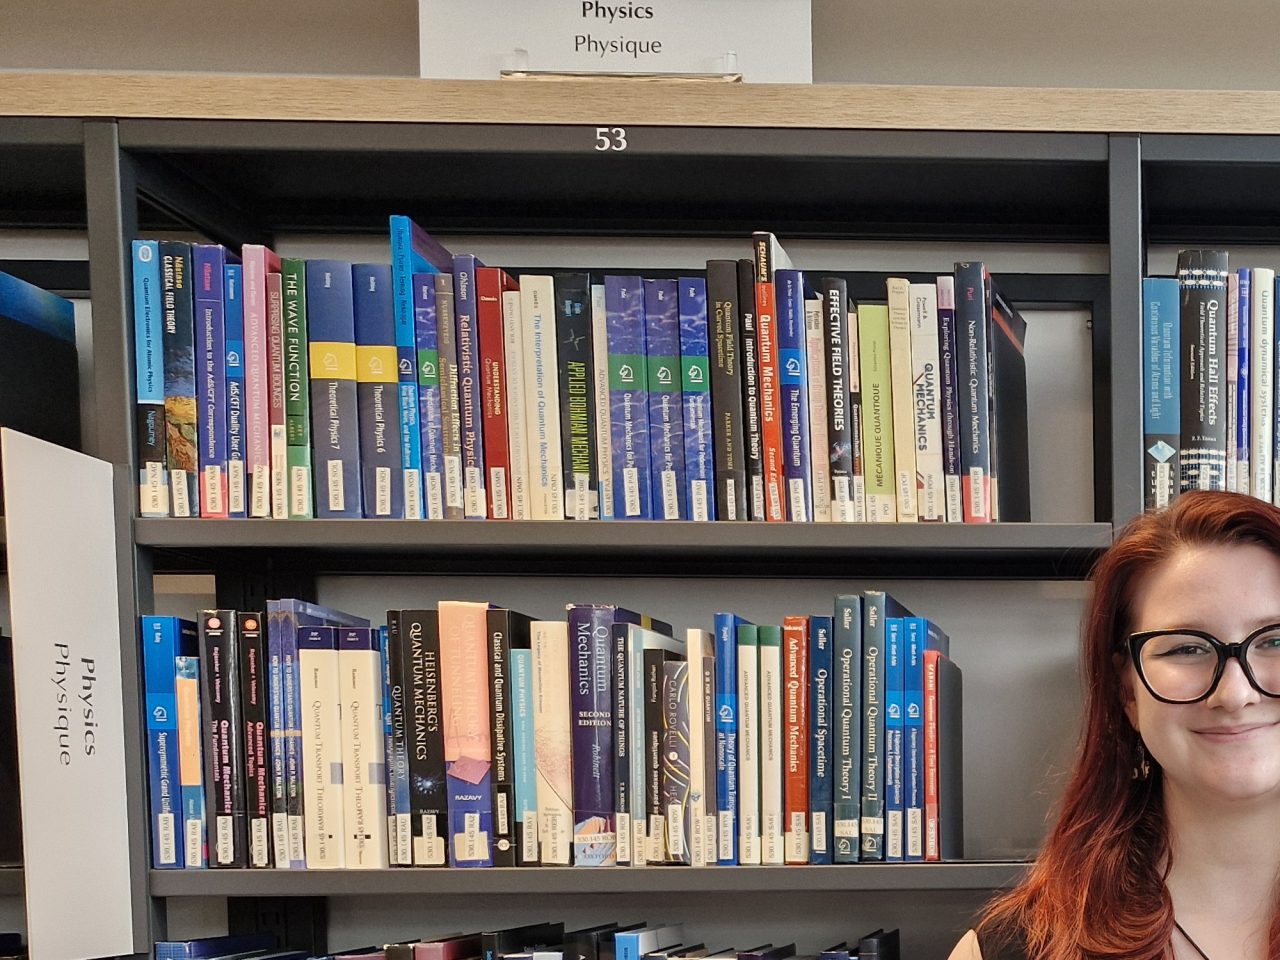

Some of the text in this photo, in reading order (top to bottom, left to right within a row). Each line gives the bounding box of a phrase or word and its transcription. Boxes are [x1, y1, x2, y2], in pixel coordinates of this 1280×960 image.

[574, 34, 663, 58] Physique
[581, 1, 654, 24] Physics
[595, 128, 628, 151] 53
[758, 241, 767, 281] SCHAUM'S
[286, 273, 300, 401] THE WAVE FUNCTION
[760, 315, 774, 422] Quantum Mechanics
[829, 290, 844, 431] EFFECTIVE FIELD THEORIES
[1207, 300, 1219, 425] Quantum Hall Effects
[915, 383, 926, 451] MECHANICS
[925, 363, 935, 420] QUANTUM
[968, 320, 980, 454] Non-Relativistic Quantum Mechanics
[51, 643, 72, 766] Physique
[78, 657, 98, 756] Physics
[410, 622, 426, 760] QUANTUM MECHANICS
[426, 652, 438, 732] HEISENBERG'S
[577, 622, 591, 695] Mechanics
[594, 626, 608, 692] Quantum
[788, 638, 800, 772] Advanced Quantum Mechanics
[866, 647, 878, 800] Operational Quantum Theory II
